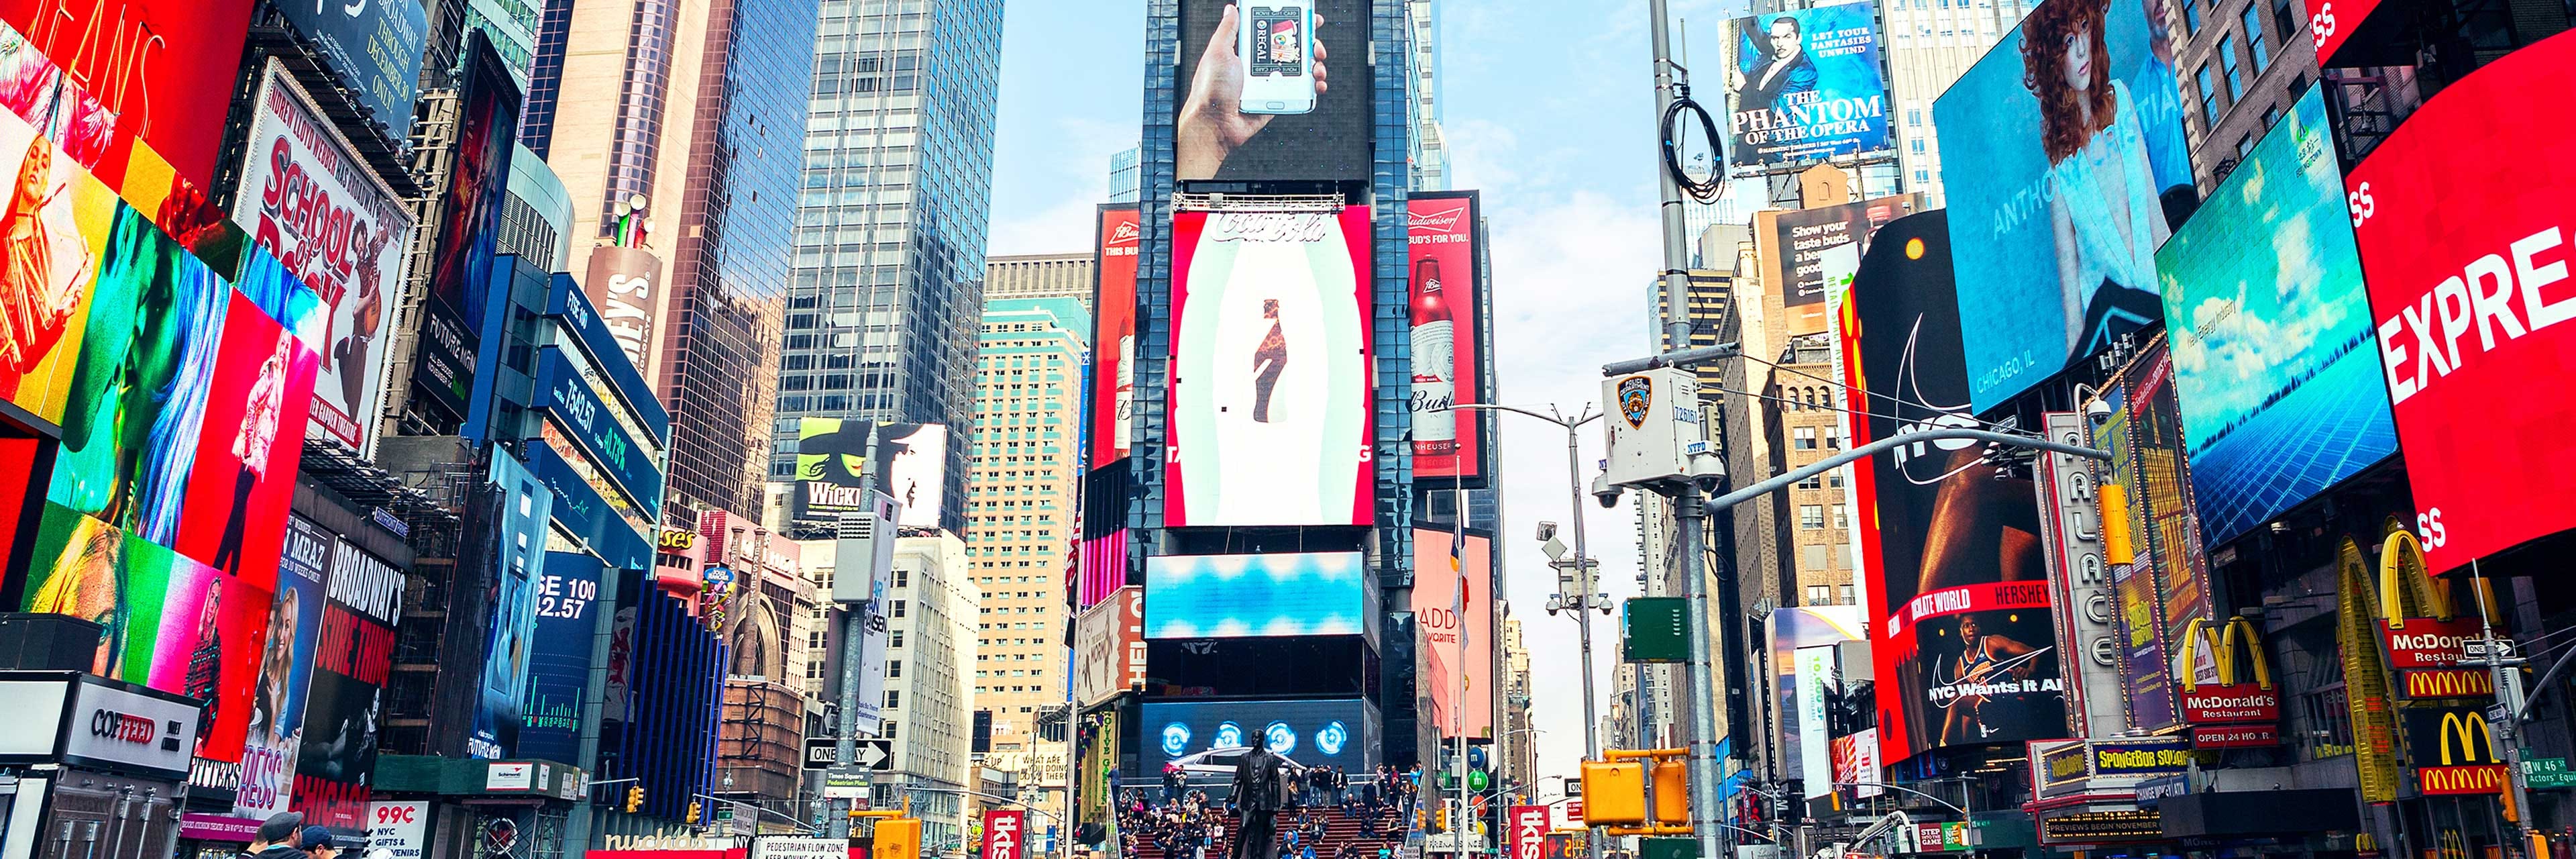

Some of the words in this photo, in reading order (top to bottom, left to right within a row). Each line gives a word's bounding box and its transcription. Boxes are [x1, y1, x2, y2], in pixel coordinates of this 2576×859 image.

[378, 0, 419, 53] BROADWAY
[1813, 32, 1833, 42] LET
[1837, 27, 1870, 38] YOUR
[378, 17, 411, 73] THROUGH
[1257, 30, 1267, 62] REGAL
[1811, 35, 1872, 50] FANTASIES
[1818, 46, 1866, 58] UNWIND
[367, 34, 402, 94] DECEMBER
[399, 82, 410, 102] 30
[372, 74, 396, 114] ONLY!
[1783, 90, 1822, 106] THE
[1731, 95, 1882, 135] PHANTOM
[1745, 131, 1772, 146] OF
[1772, 126, 1811, 142] THE
[1810, 119, 1871, 138] OPERA
[292, 107, 315, 150] LLOYD
[313, 130, 337, 176] WEBBER
[335, 160, 348, 189] HAS
[347, 170, 377, 218] BROADWAY
[263, 135, 355, 282] SCHOOL
[1408, 215, 1458, 225] Budweiser
[1792, 224, 1822, 238] Show
[1823, 221, 1849, 235] your
[1408, 236, 1431, 244] BUD'S
[1432, 235, 1448, 244] FOR
[1450, 234, 1469, 242] YOU.
[1793, 238, 1822, 250] taste
[1823, 233, 1850, 246] buds
[295, 238, 319, 280] of
[1105, 246, 1124, 256] THIS
[1794, 253, 1803, 262] a
[1827, 276, 1838, 308] RETAIL
[566, 289, 581, 320] FTSE
[579, 306, 589, 330] 100
[2378, 225, 2576, 406] EXPRE
[2187, 333, 2198, 350] New
[2198, 316, 2216, 341] Energy
[2215, 300, 2237, 325] Industry
[429, 312, 461, 360] FUTURE
[460, 348, 477, 374] MAN
[1625, 378, 1643, 387] POLICE
[1976, 356, 2023, 395] CHICAGO,
[2024, 350, 2035, 368] IL
[451, 374, 466, 401] hulu
[1620, 385, 1650, 397] DEPARTMENT
[564, 378, 596, 435] 7542.57
[1674, 406, 1697, 423] 726161
[318, 400, 337, 429] GARDEN
[336, 413, 357, 443] THEATRE
[603, 427, 627, 471] +0.73%
[1687, 442, 1706, 453] NYPD
[290, 532, 325, 572] MRAZ
[2061, 431, 2114, 667] PALACE
[329, 540, 406, 627] BROADWAY'S
[748, 540, 761, 605] HERSHEYS
[568, 578, 596, 601] 100
[1934, 589, 1971, 613] WORLD
[865, 611, 888, 634] ANSEN
[1419, 607, 1456, 629] ADD
[317, 604, 359, 676] SURE
[354, 619, 395, 690] THING
[2469, 646, 2483, 654] ONE
[1929, 685, 1955, 701] NYC
[1957, 681, 2020, 697] Wants
[2023, 678, 2037, 692] It
[2187, 694, 2275, 709] McDonald's
[2202, 709, 2261, 719] Restaurant
[91, 709, 156, 744] COFFEED
[2198, 734, 2224, 742] OPEN
[2228, 733, 2239, 742] 24
[466, 738, 490, 758] FUTURE
[814, 748, 836, 760] ONE
[1470, 754, 1478, 762] m
[2099, 749, 2155, 769] SPONGEBOB
[991, 757, 1002, 766] UP
[1046, 756, 1061, 764] ARE
[2532, 761, 2542, 771] W
[2544, 760, 2557, 771] 46
[1046, 772, 1066, 780] THER
[1473, 776, 1482, 785] m
[2530, 772, 2557, 782] Actors'
[1570, 783, 1582, 792] ON
[2137, 786, 2155, 801] CHANGE
[2174, 782, 2185, 797] ATM
[288, 772, 372, 831] CHICAGO
[377, 805, 416, 824] 99¢
[991, 815, 1017, 859] tkts
[1520, 810, 1544, 859] tkts
[2050, 823, 2089, 832] PREVIEWS
[2090, 823, 2114, 831] BEGIN
[2116, 821, 2157, 831] NOVEMBER
[605, 828, 710, 851] nuchas
[767, 842, 806, 852] PEDESTRIAN
[808, 843, 826, 852] FLOW
[826, 843, 844, 852] ZONE
[391, 849, 420, 857] VENIRS
